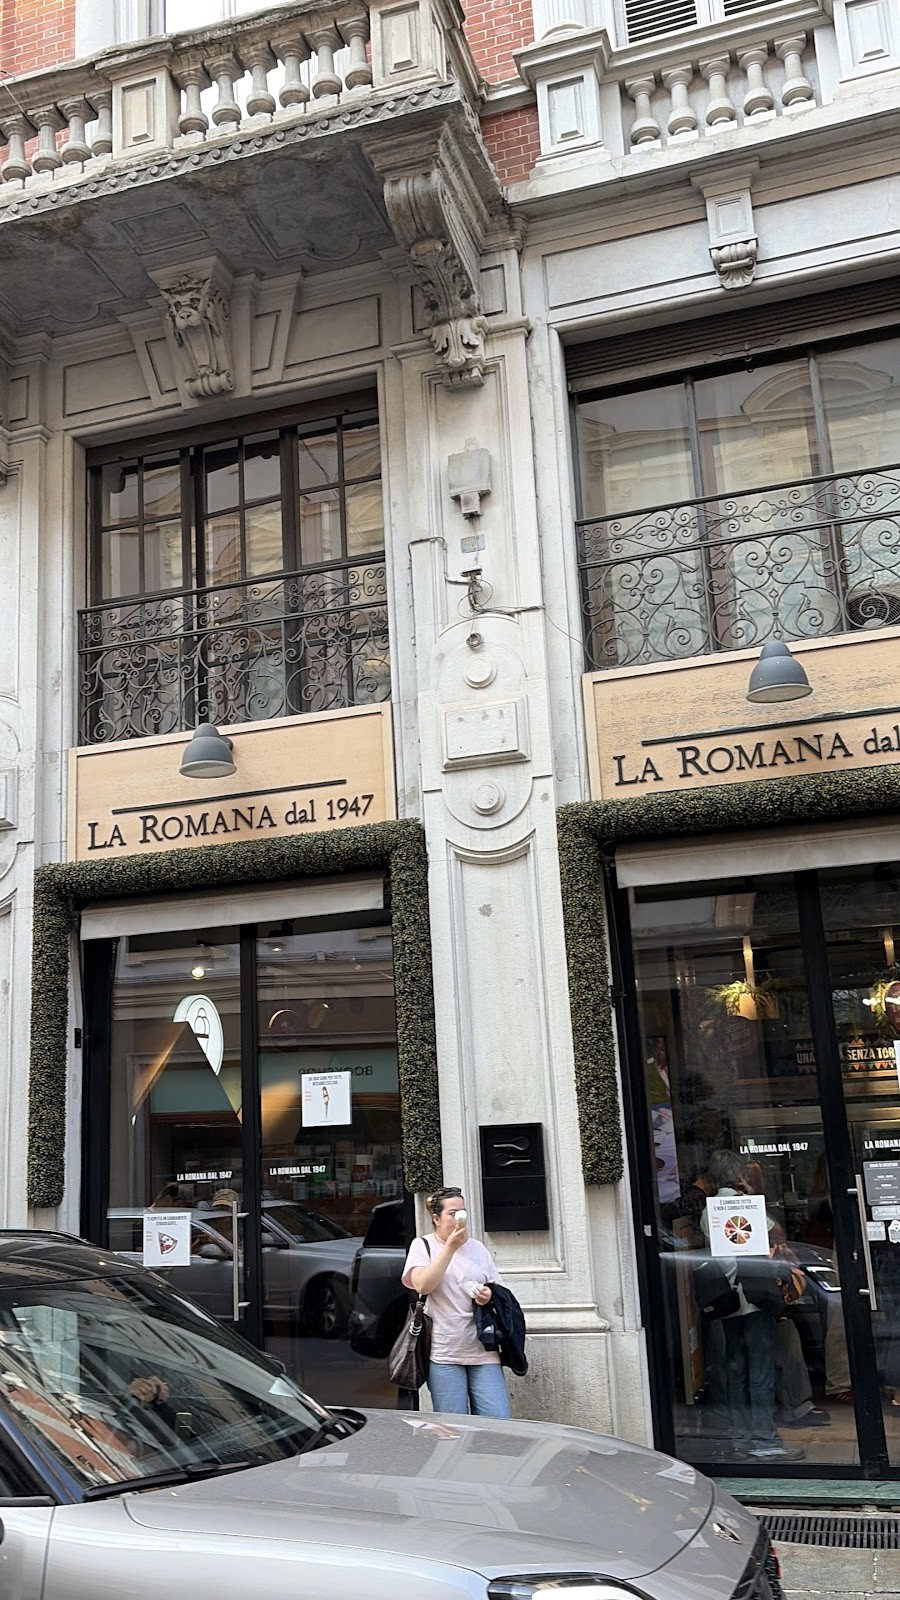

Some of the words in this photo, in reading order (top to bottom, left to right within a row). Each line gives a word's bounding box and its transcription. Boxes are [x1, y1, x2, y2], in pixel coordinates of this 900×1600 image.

[612, 754, 663, 786] LA
[676, 732, 854, 778] ROMANA
[863, 724, 900, 755] dal
[87, 821, 127, 850] LA
[138, 805, 277, 843] ROMANA
[284, 799, 317, 825] dal
[326, 794, 375, 820] 1947
[796, 1052, 816, 1064] UNA
[847, 1048, 876, 1060] SENZA
[876, 1046, 896, 1060] TOR
[740, 1146, 749, 1154] LA
[750, 1144, 778, 1153] ROMANA
[778, 1143, 791, 1152] DAL
[792, 1142, 808, 1151] 1947
[864, 1140, 874, 1149] LA
[874, 1138, 900, 1149] ROMAN
[176, 1173, 184, 1181] LA
[185, 1172, 207, 1181] ROMANA
[207, 1171, 218, 1180] DAL
[219, 1171, 232, 1179] 1947
[269, 1167, 277, 1175] LA
[277, 1166, 300, 1175] ROMANA
[301, 1166, 312, 1174] DAL
[312, 1165, 326, 1173] 1947
